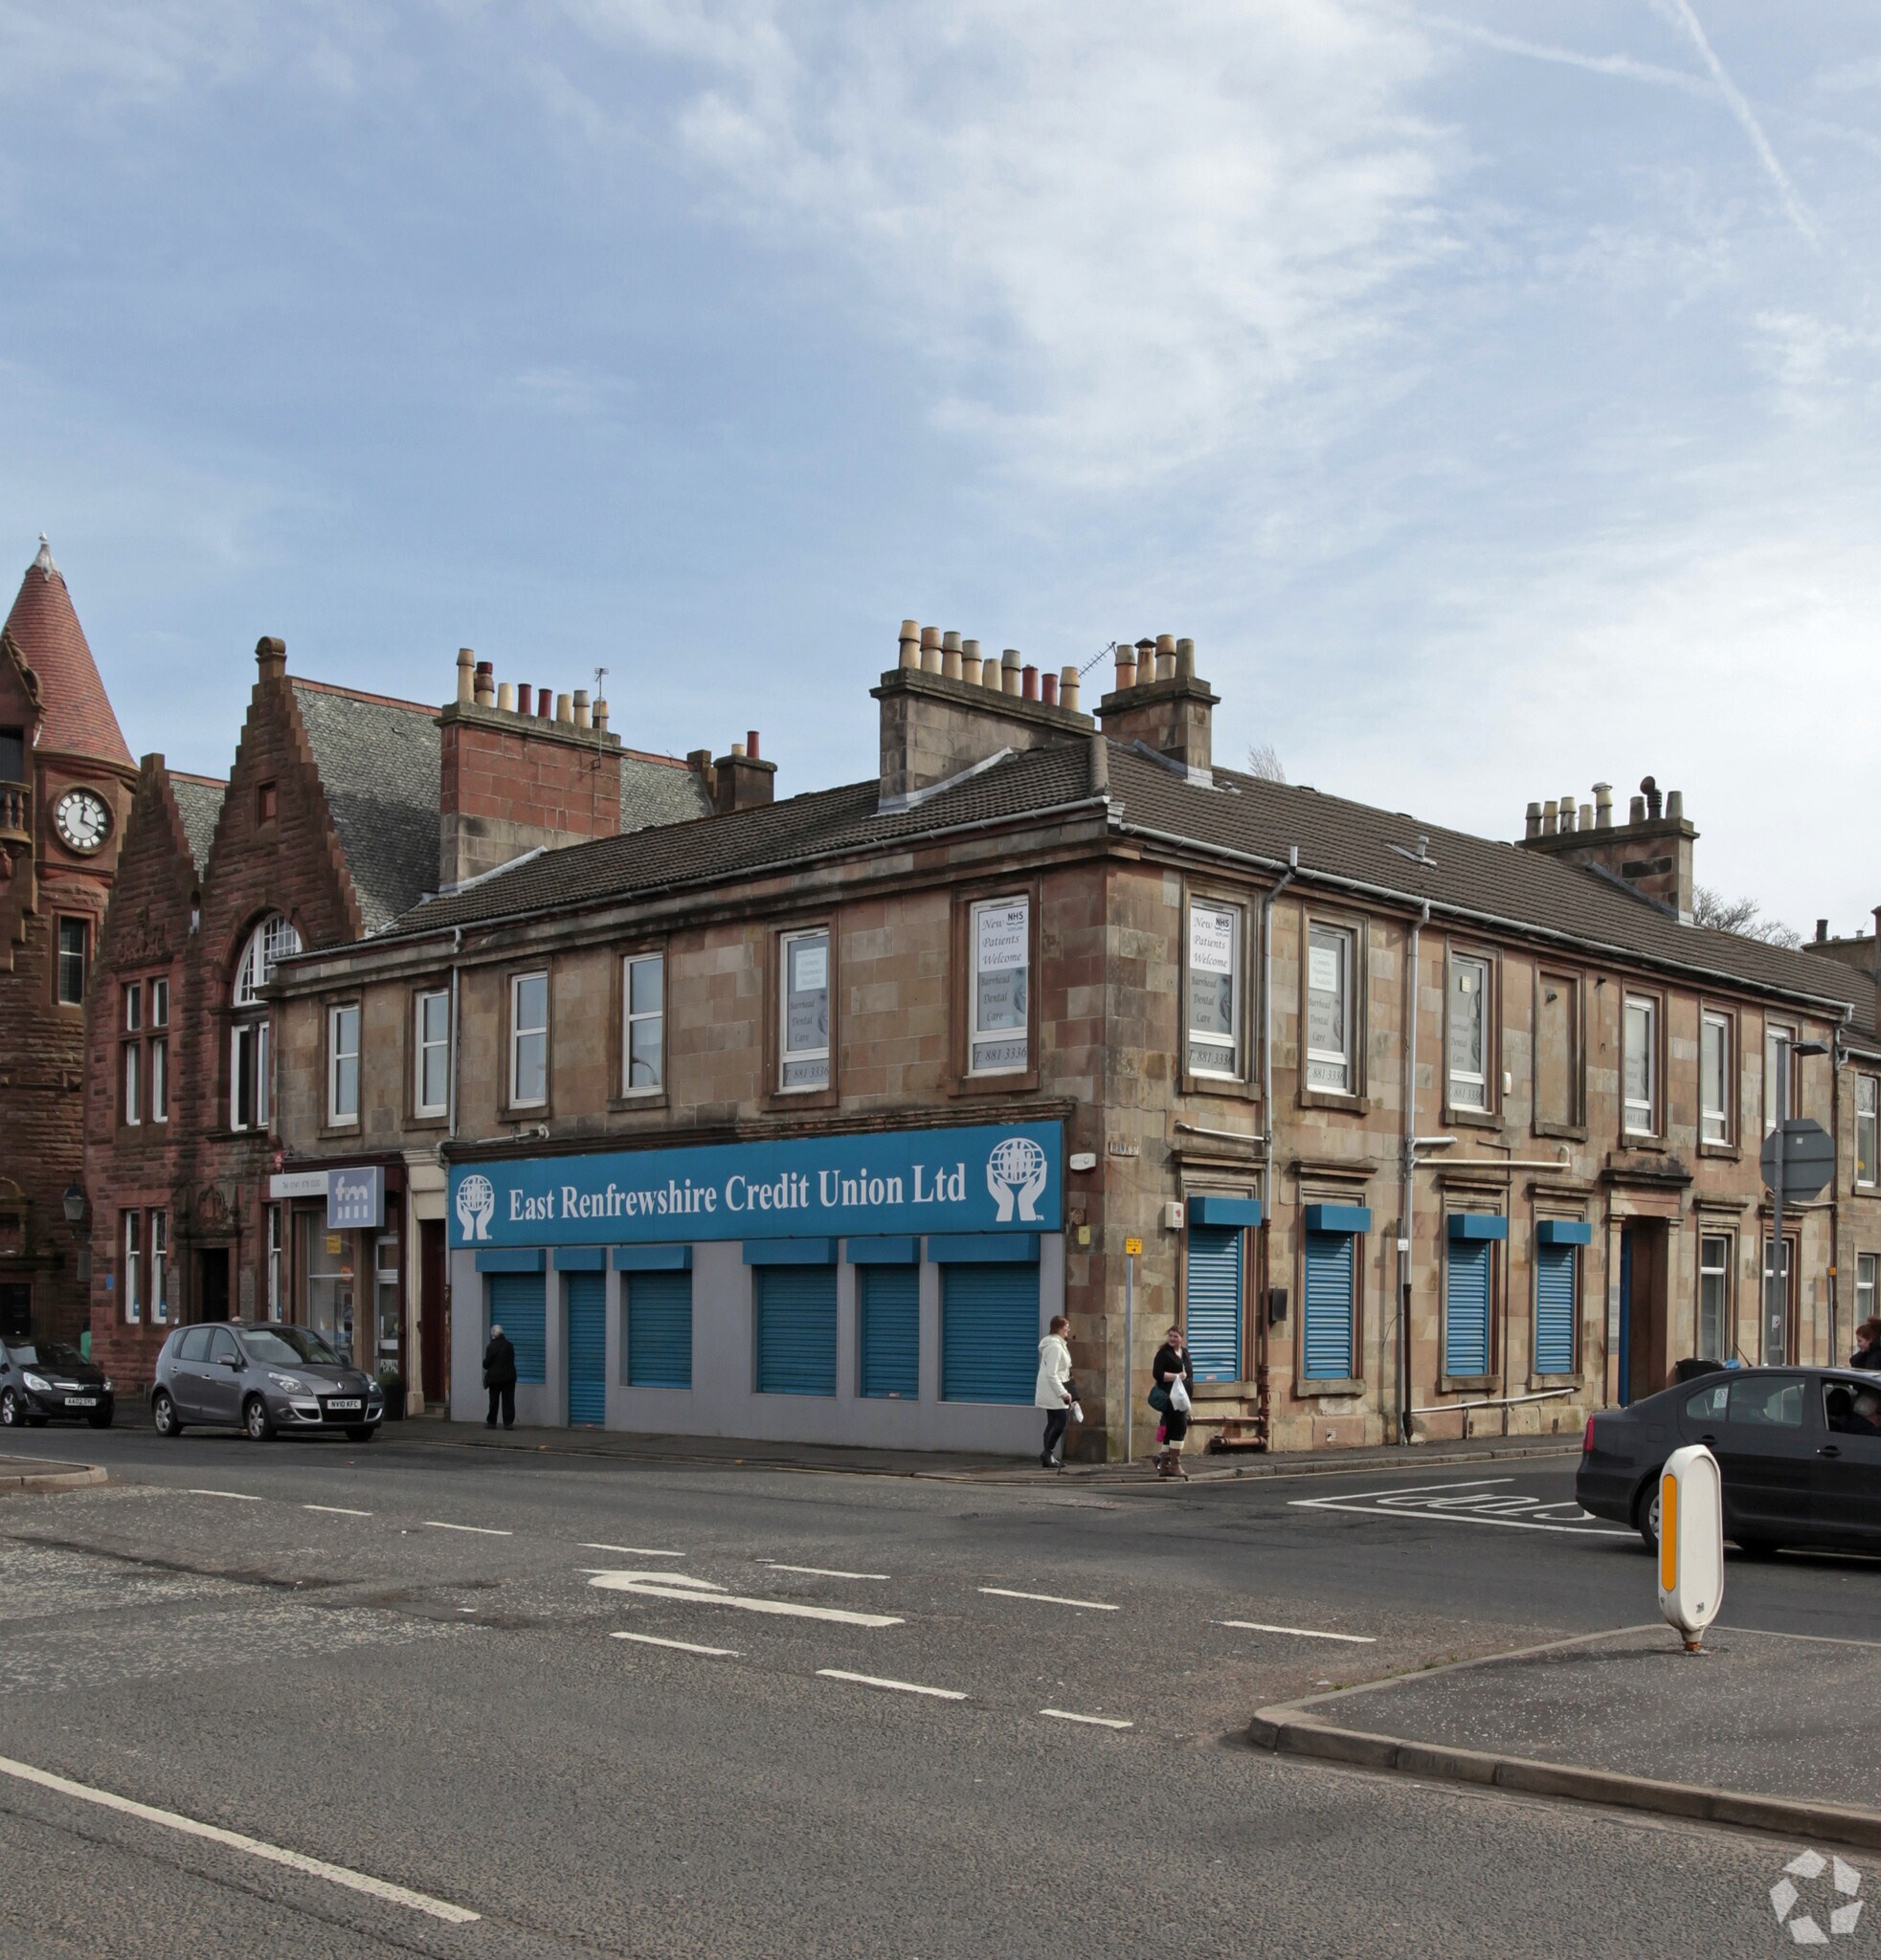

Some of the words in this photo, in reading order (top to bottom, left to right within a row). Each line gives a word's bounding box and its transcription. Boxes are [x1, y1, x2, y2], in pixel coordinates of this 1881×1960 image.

[1007, 911, 1023, 921] NHS
[1215, 918, 1230, 927] NHS
[982, 918, 1004, 930] New
[1194, 917, 1213, 929] New
[982, 935, 1019, 947] Patients
[1194, 934, 1225, 949] Patients
[982, 951, 1022, 966] Welcome
[1194, 952, 1228, 968] Welcome
[980, 974, 1010, 987] Barrhead
[1191, 976, 1218, 989] Barrhead
[983, 992, 1008, 1005] Dental
[1194, 993, 1216, 1006] Dental
[792, 1015, 813, 1027] Dental
[986, 1012, 1003, 1023] Care
[1196, 1012, 1211, 1024] Care
[1310, 1013, 1330, 1026] Dental
[795, 1033, 810, 1043] Care
[1312, 1033, 1326, 1043] Care
[985, 1048, 1001, 1062] 881
[1004, 1046, 1027, 1060] 3336
[1197, 1050, 1212, 1064] 881
[793, 1067, 808, 1080] 881
[810, 1065, 829, 1079] 3336
[1312, 1067, 1326, 1080] 881
[508, 1189, 555, 1221] East
[560, 1178, 717, 1219] Renfrewshire
[725, 1171, 810, 1212] Credit
[817, 1168, 905, 1208] Union
[911, 1162, 967, 1204] Ltd
